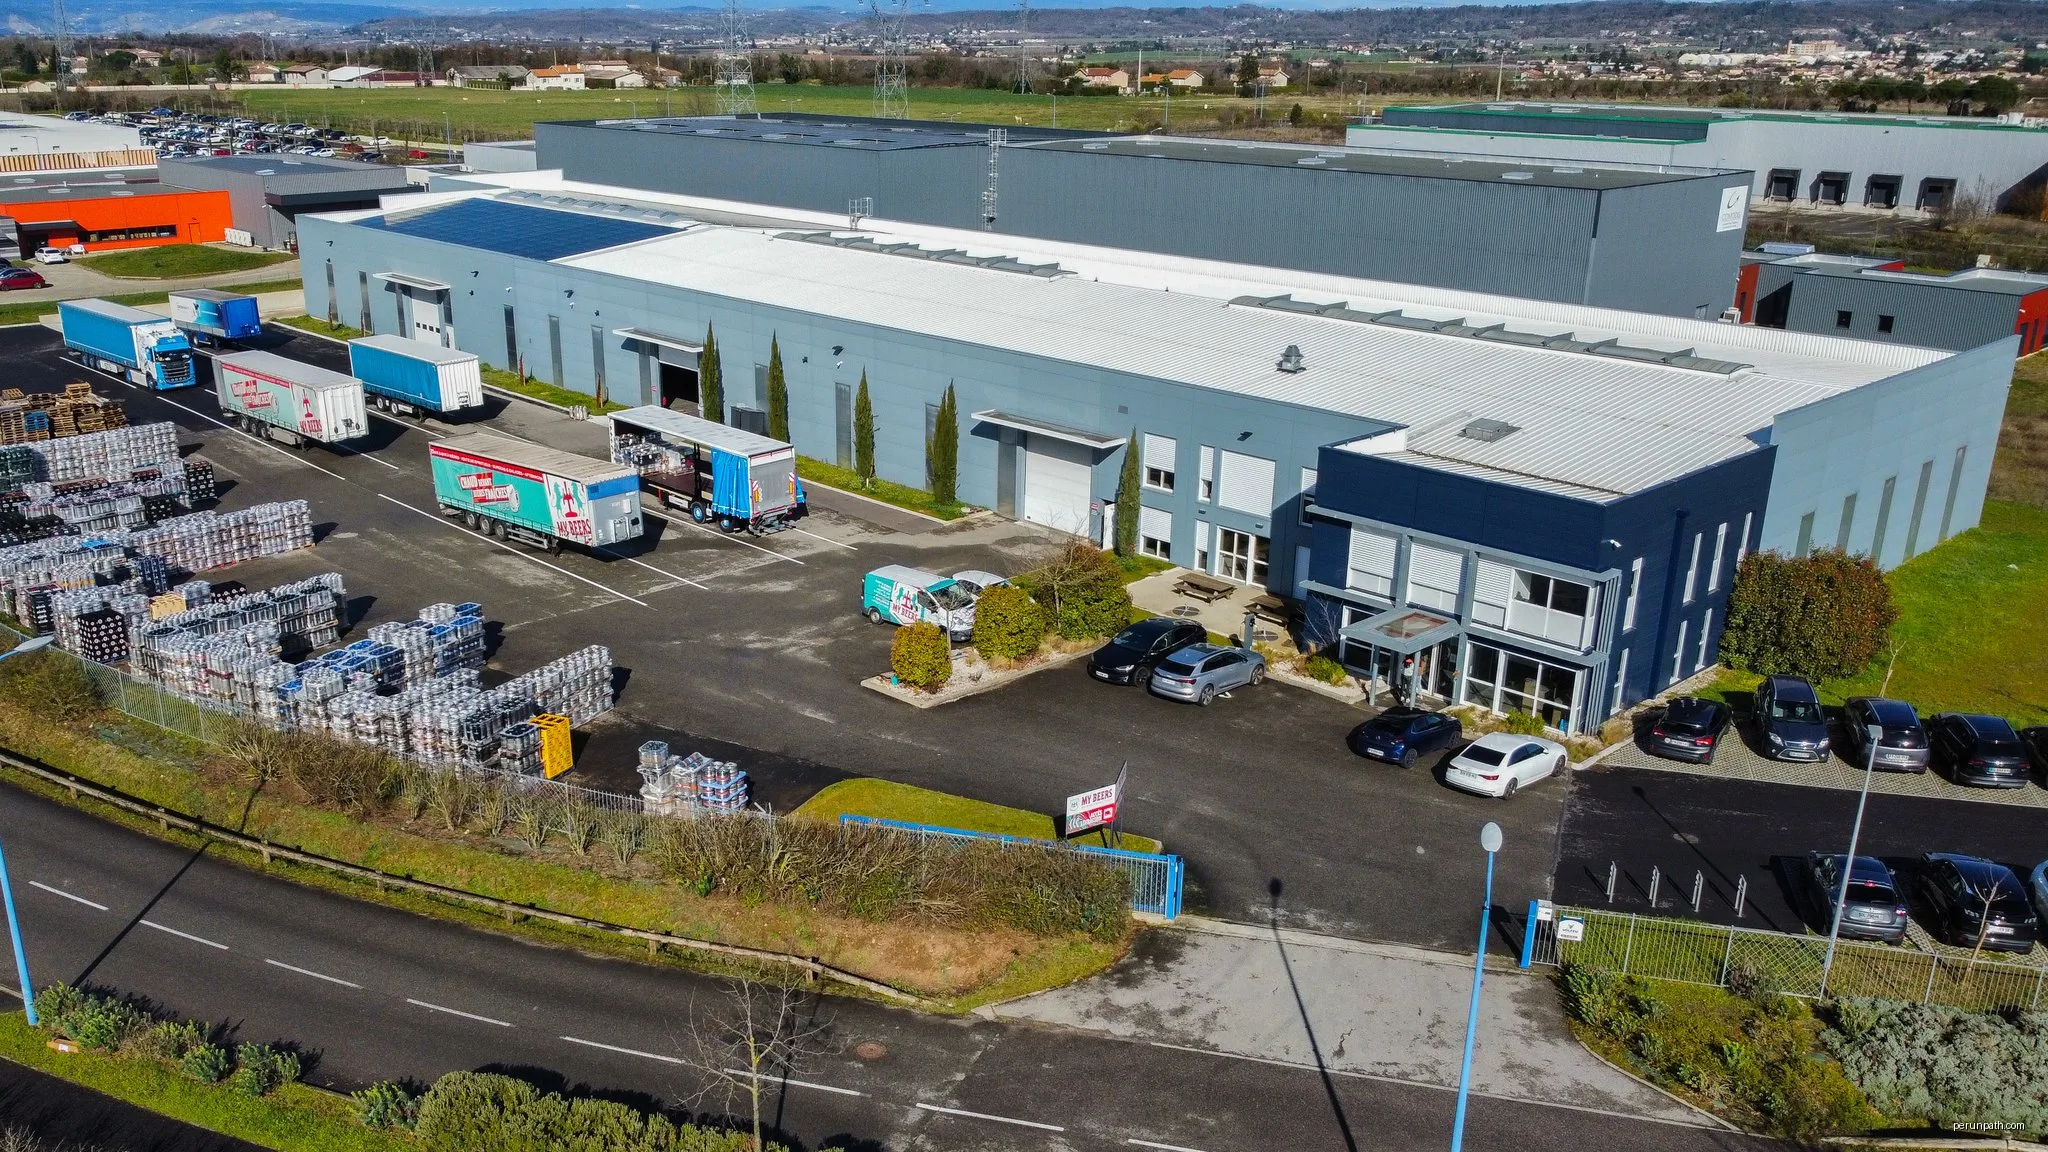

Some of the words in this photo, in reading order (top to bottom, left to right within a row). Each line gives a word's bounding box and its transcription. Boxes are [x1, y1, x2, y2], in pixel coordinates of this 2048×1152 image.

[557, 521, 569, 537] MY
[568, 519, 592, 536] BEERS
[892, 603, 901, 614] MY
[901, 607, 919, 621] BEERS
[1081, 795, 1092, 805] MY
[1092, 789, 1113, 803] BEERS
